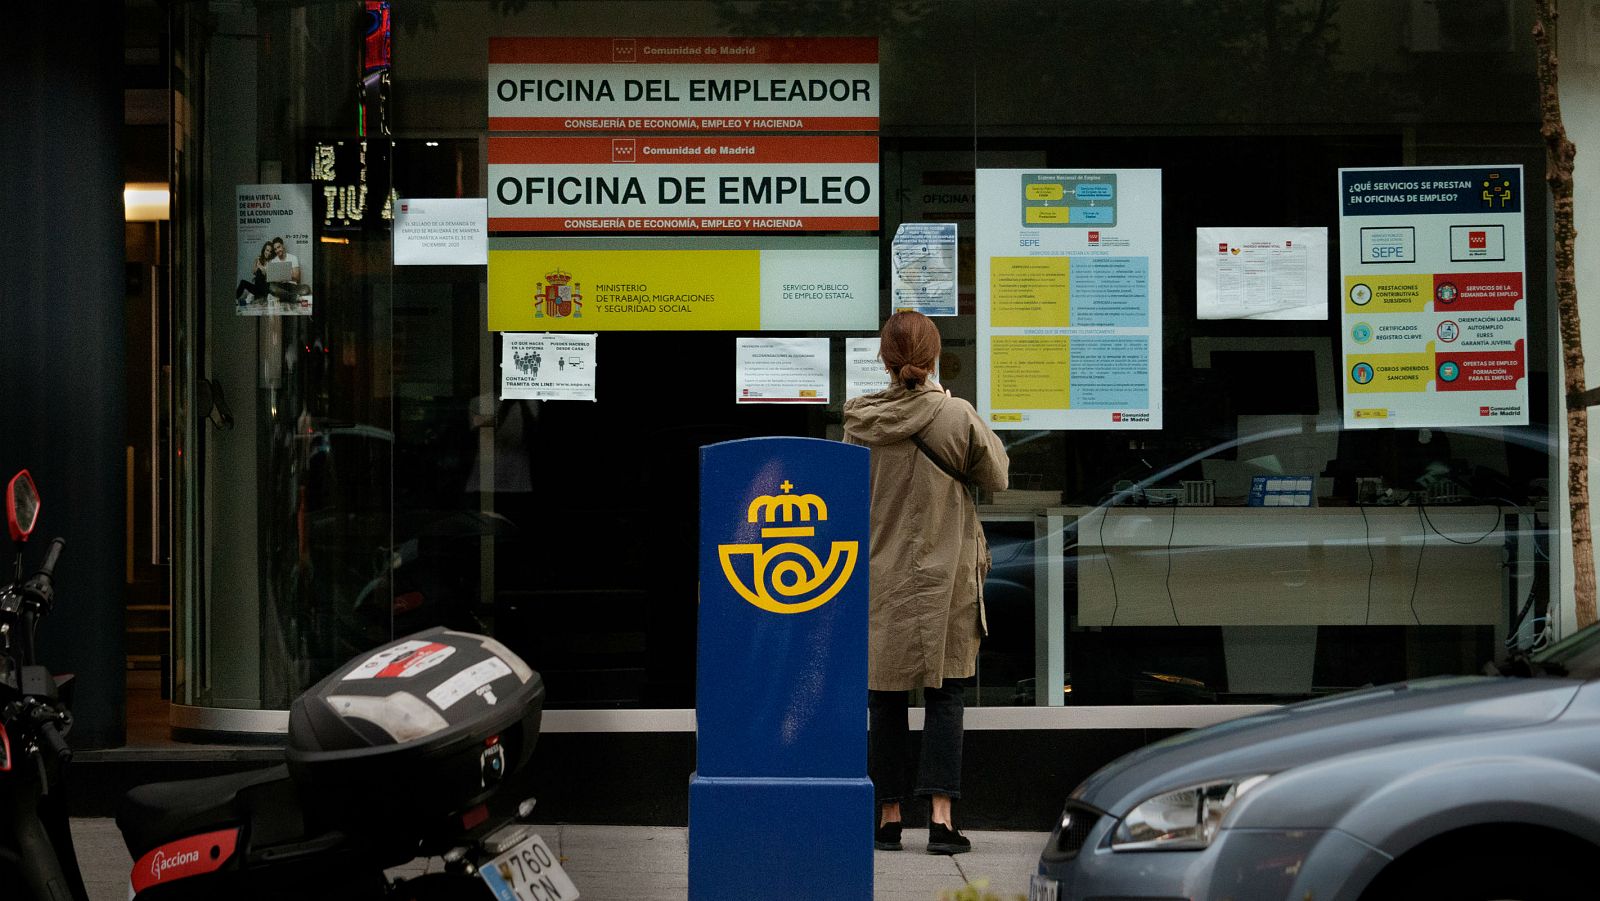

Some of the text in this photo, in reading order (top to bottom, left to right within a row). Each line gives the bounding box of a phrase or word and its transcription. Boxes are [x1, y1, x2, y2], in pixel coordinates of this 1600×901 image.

[643, 45, 756, 55] Comunidad de Madrid
[496, 79, 871, 102] OFICINA DEL EMPLEADOR
[564, 118, 803, 130] CONSEJERÍA DE ECONOMÍA, EMPLEO Y HACIENDA
[642, 145, 756, 155] Comunidad de Madrid
[496, 175, 871, 206] OFICINA DE EMPLEO
[1349, 181, 1472, 193] ¿QUÉ SERVICIOS SE PRESTAN
[1351, 194, 1458, 204] EN OFICINAS DE EMPLEO?
[564, 217, 803, 230] CONSEJERÍA DE ECONOMÍA, EMPLEO Y HACIENDA
[1019, 239, 1040, 247] SEPE
[1372, 246, 1404, 259] SEPE
[596, 284, 648, 292] MINISTERIO
[817, 283, 849, 291] PÚBLICO
[596, 294, 609, 303] DE
[652, 294, 715, 303] MIGRACIONES
[596, 305, 692, 313] Y SEGURIDAD SOCIAL
[484, 744, 499, 758] PRESS
[160, 850, 199, 870] acciona
